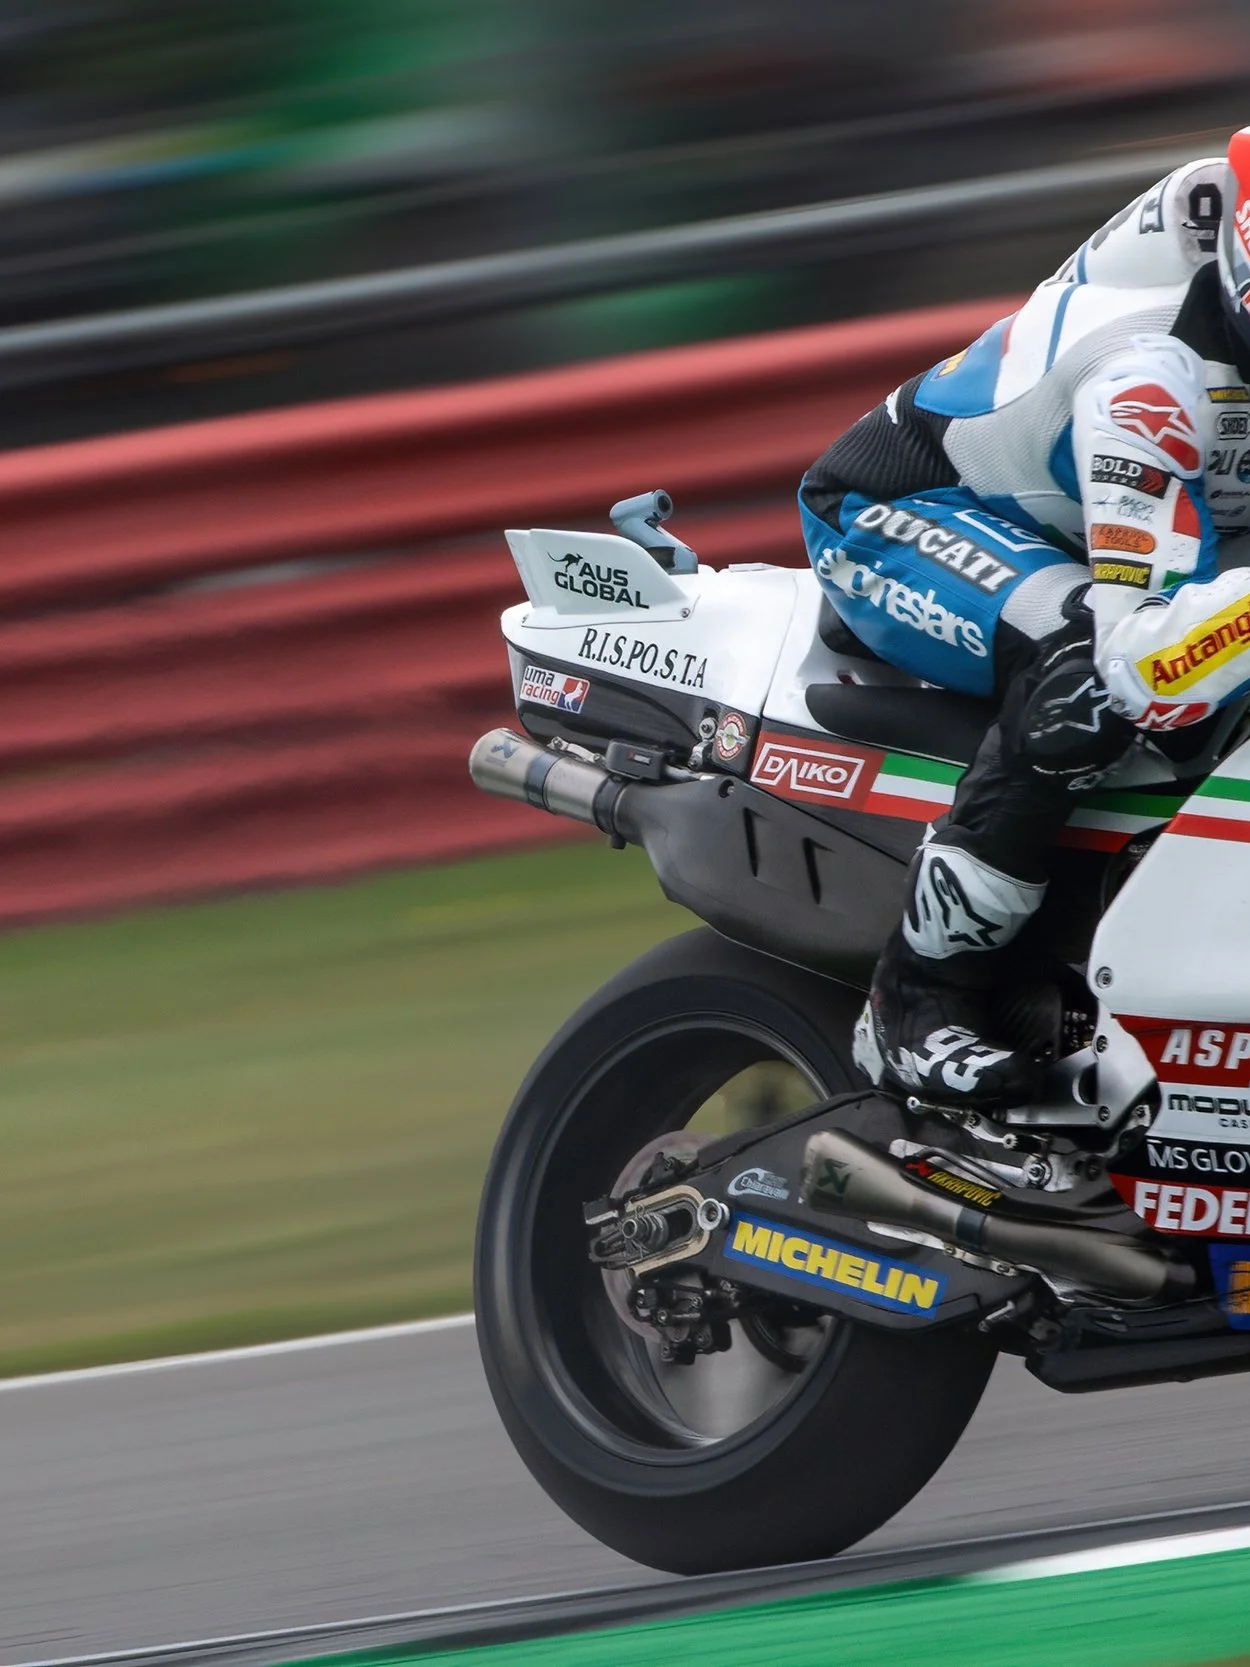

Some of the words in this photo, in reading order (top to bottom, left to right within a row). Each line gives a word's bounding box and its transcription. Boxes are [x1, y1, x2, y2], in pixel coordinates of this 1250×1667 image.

[1092, 457, 1143, 478] BOLD
[854, 503, 1019, 593] DUCATI
[555, 571, 649, 609] GLOBAL
[579, 562, 628, 588] AUS
[817, 548, 988, 657] alpinestars
[524, 667, 554, 687] uma
[522, 683, 560, 704] racing
[763, 755, 848, 785] DAIKO
[911, 1026, 1014, 1093] 93
[1147, 1143, 1189, 1170] MS
[732, 1220, 938, 1310] MICHELIN
